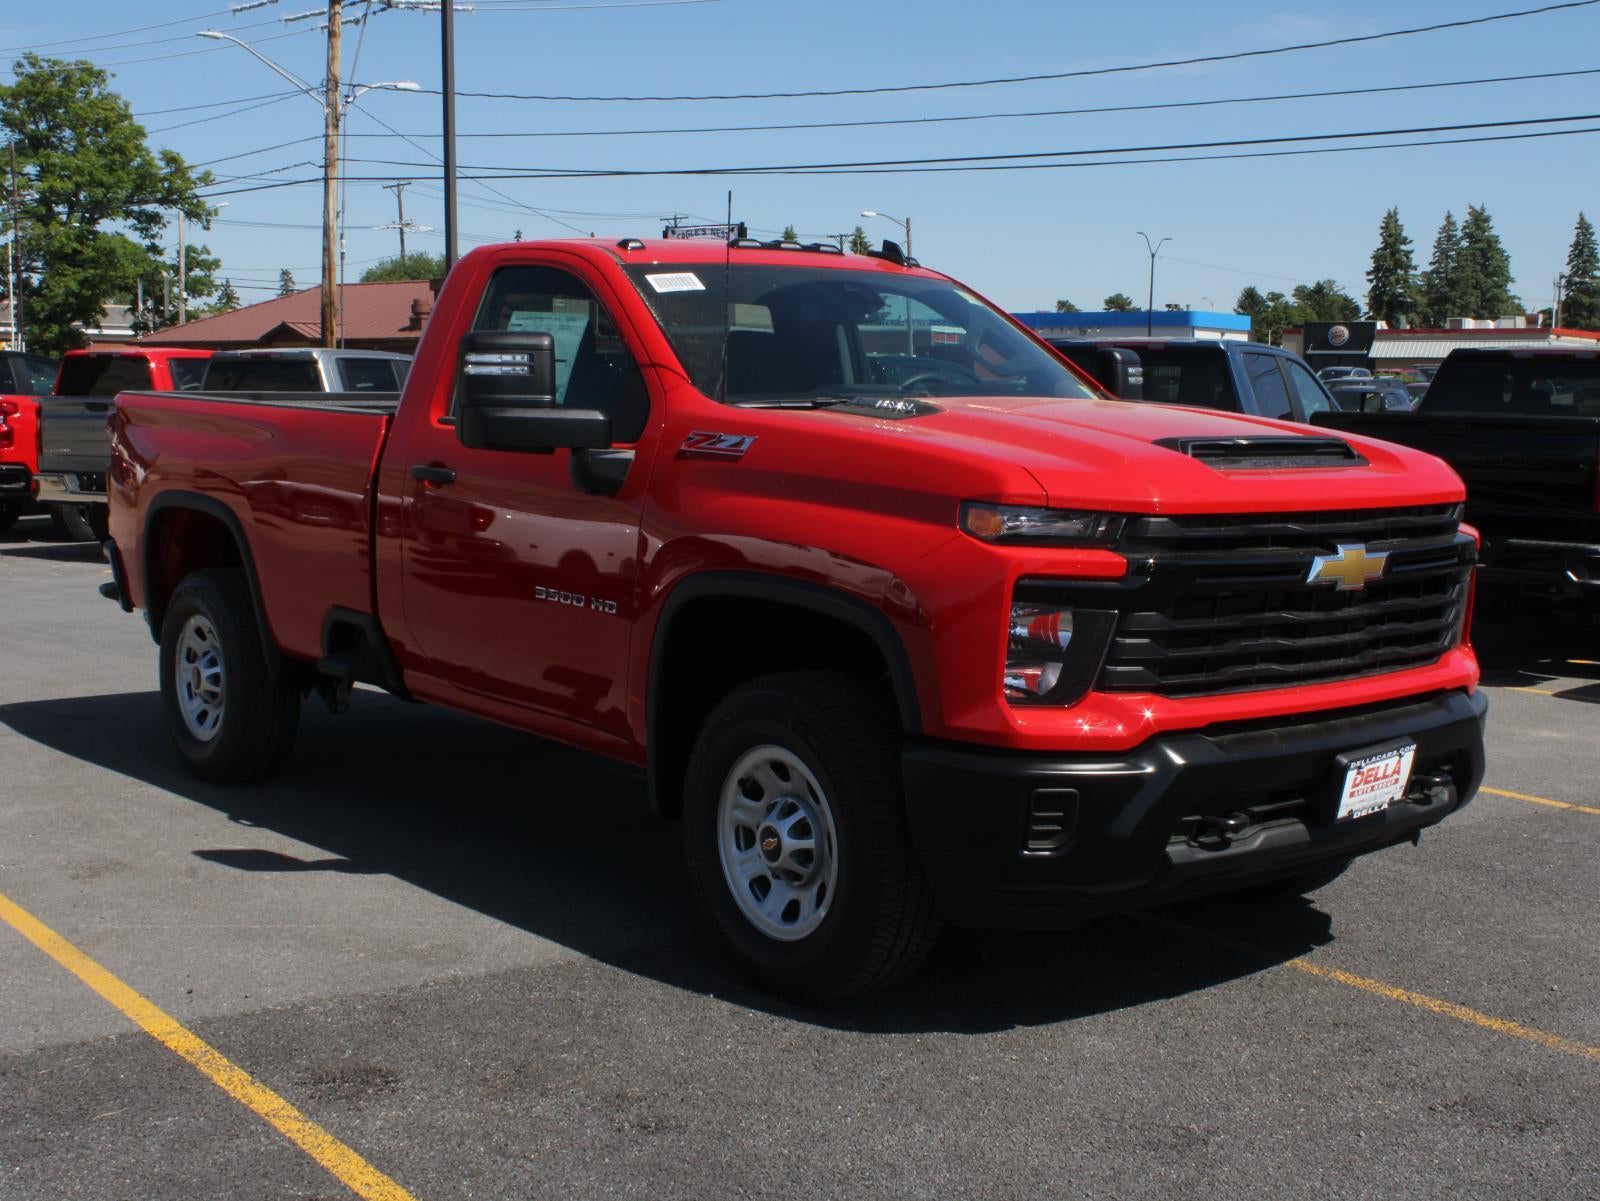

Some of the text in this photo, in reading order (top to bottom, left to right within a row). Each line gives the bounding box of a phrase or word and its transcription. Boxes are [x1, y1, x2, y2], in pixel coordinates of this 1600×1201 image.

[680, 430, 759, 456] Z71
[535, 586, 617, 614] 3500 HD
[1351, 759, 1401, 788] DELLA
[1353, 803, 1389, 819] DELLA
